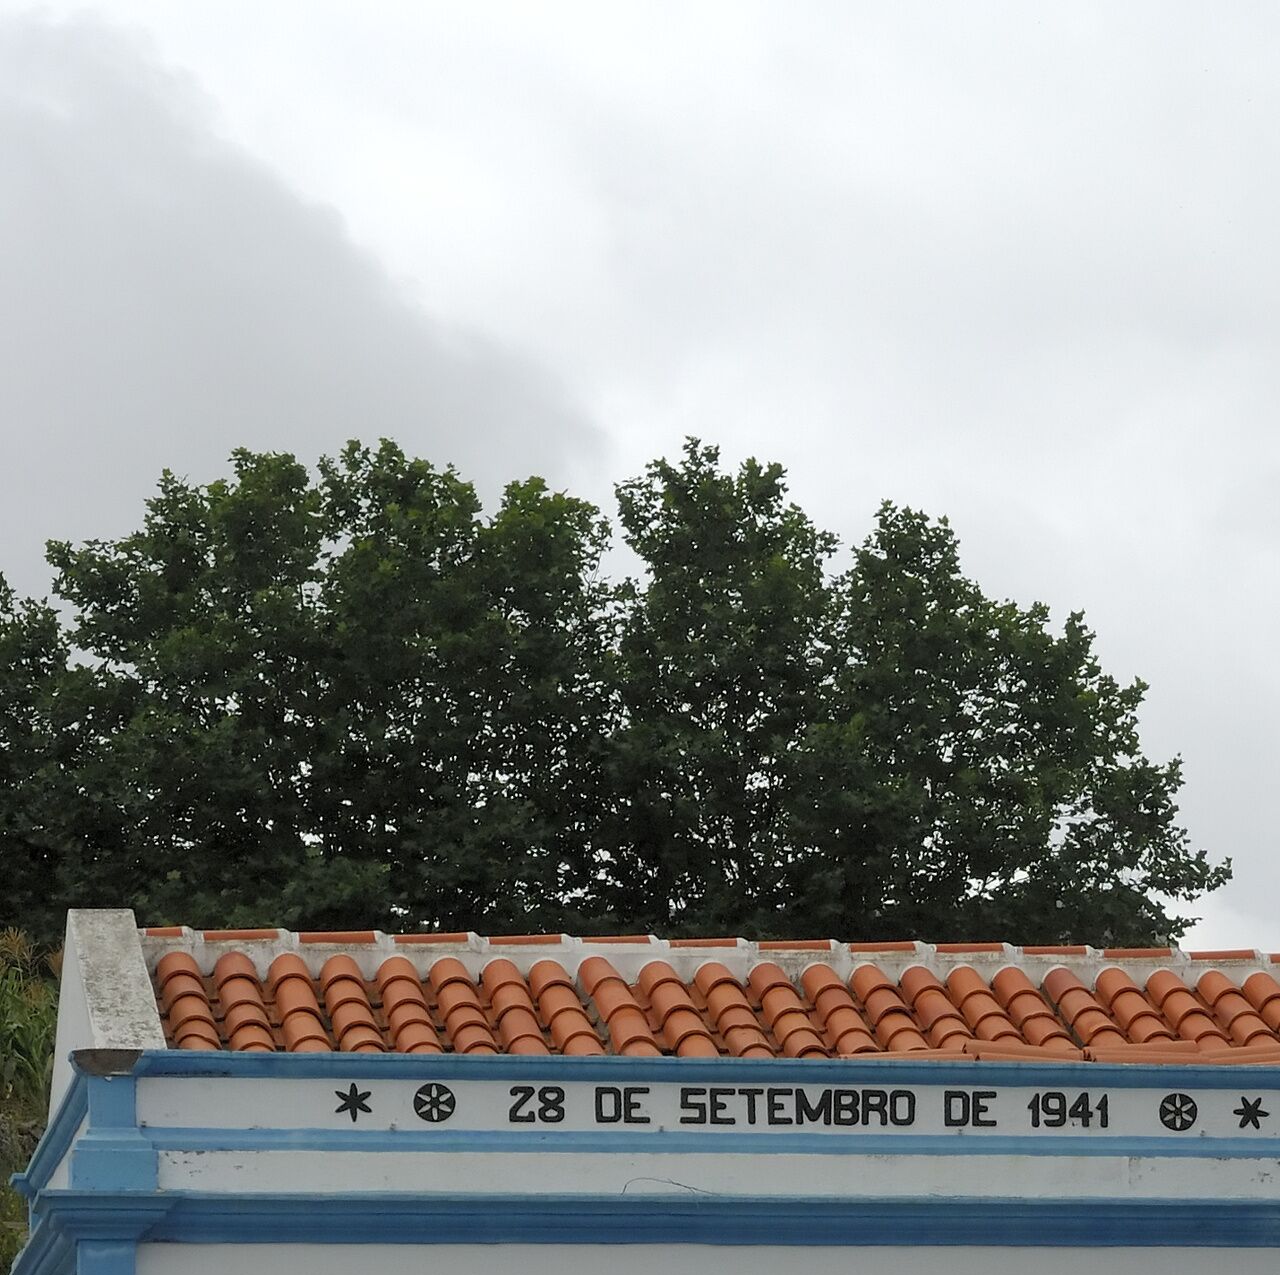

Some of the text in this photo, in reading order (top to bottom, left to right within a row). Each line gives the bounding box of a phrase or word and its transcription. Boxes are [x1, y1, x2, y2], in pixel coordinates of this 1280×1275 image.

[508, 1086, 1109, 1129] 28 DE SETEMBRO DE 1941
